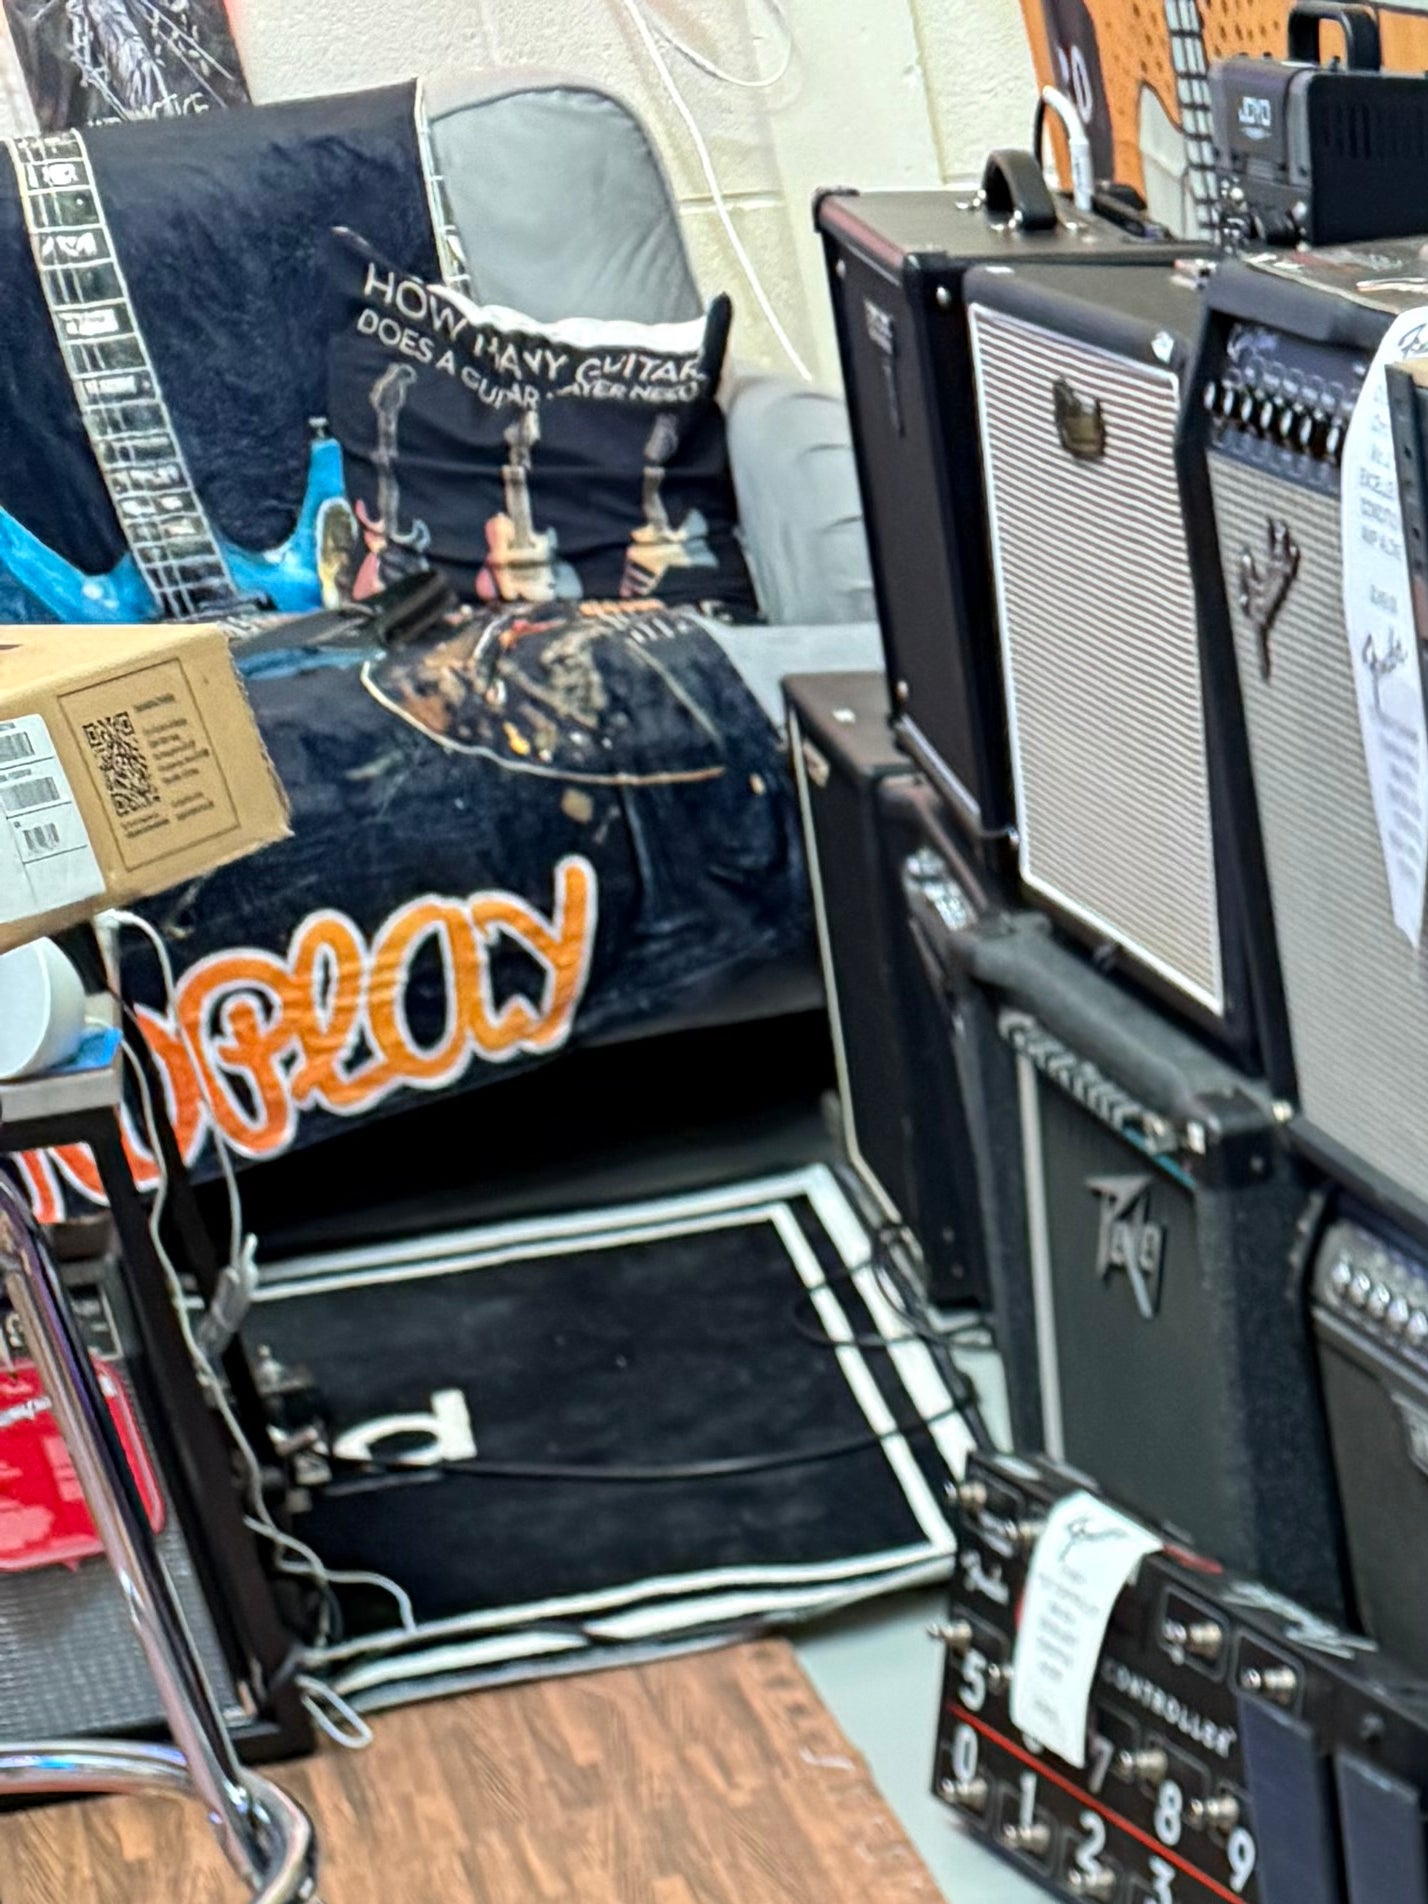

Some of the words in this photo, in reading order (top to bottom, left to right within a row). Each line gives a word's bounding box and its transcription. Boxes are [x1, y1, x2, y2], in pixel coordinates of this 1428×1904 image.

[356, 308, 435, 363] DOES
[435, 349, 456, 376] A
[363, 262, 469, 343] HOW
[1101, 1656, 1236, 1759] CONTROLLER
[951, 1722, 979, 1784] 0
[1018, 1772, 1038, 1828] 1
[1075, 1811, 1106, 1882] 2
[959, 1646, 987, 1711] 5
[1154, 1778, 1183, 1847] 8
[1226, 1825, 1256, 1892] 9
